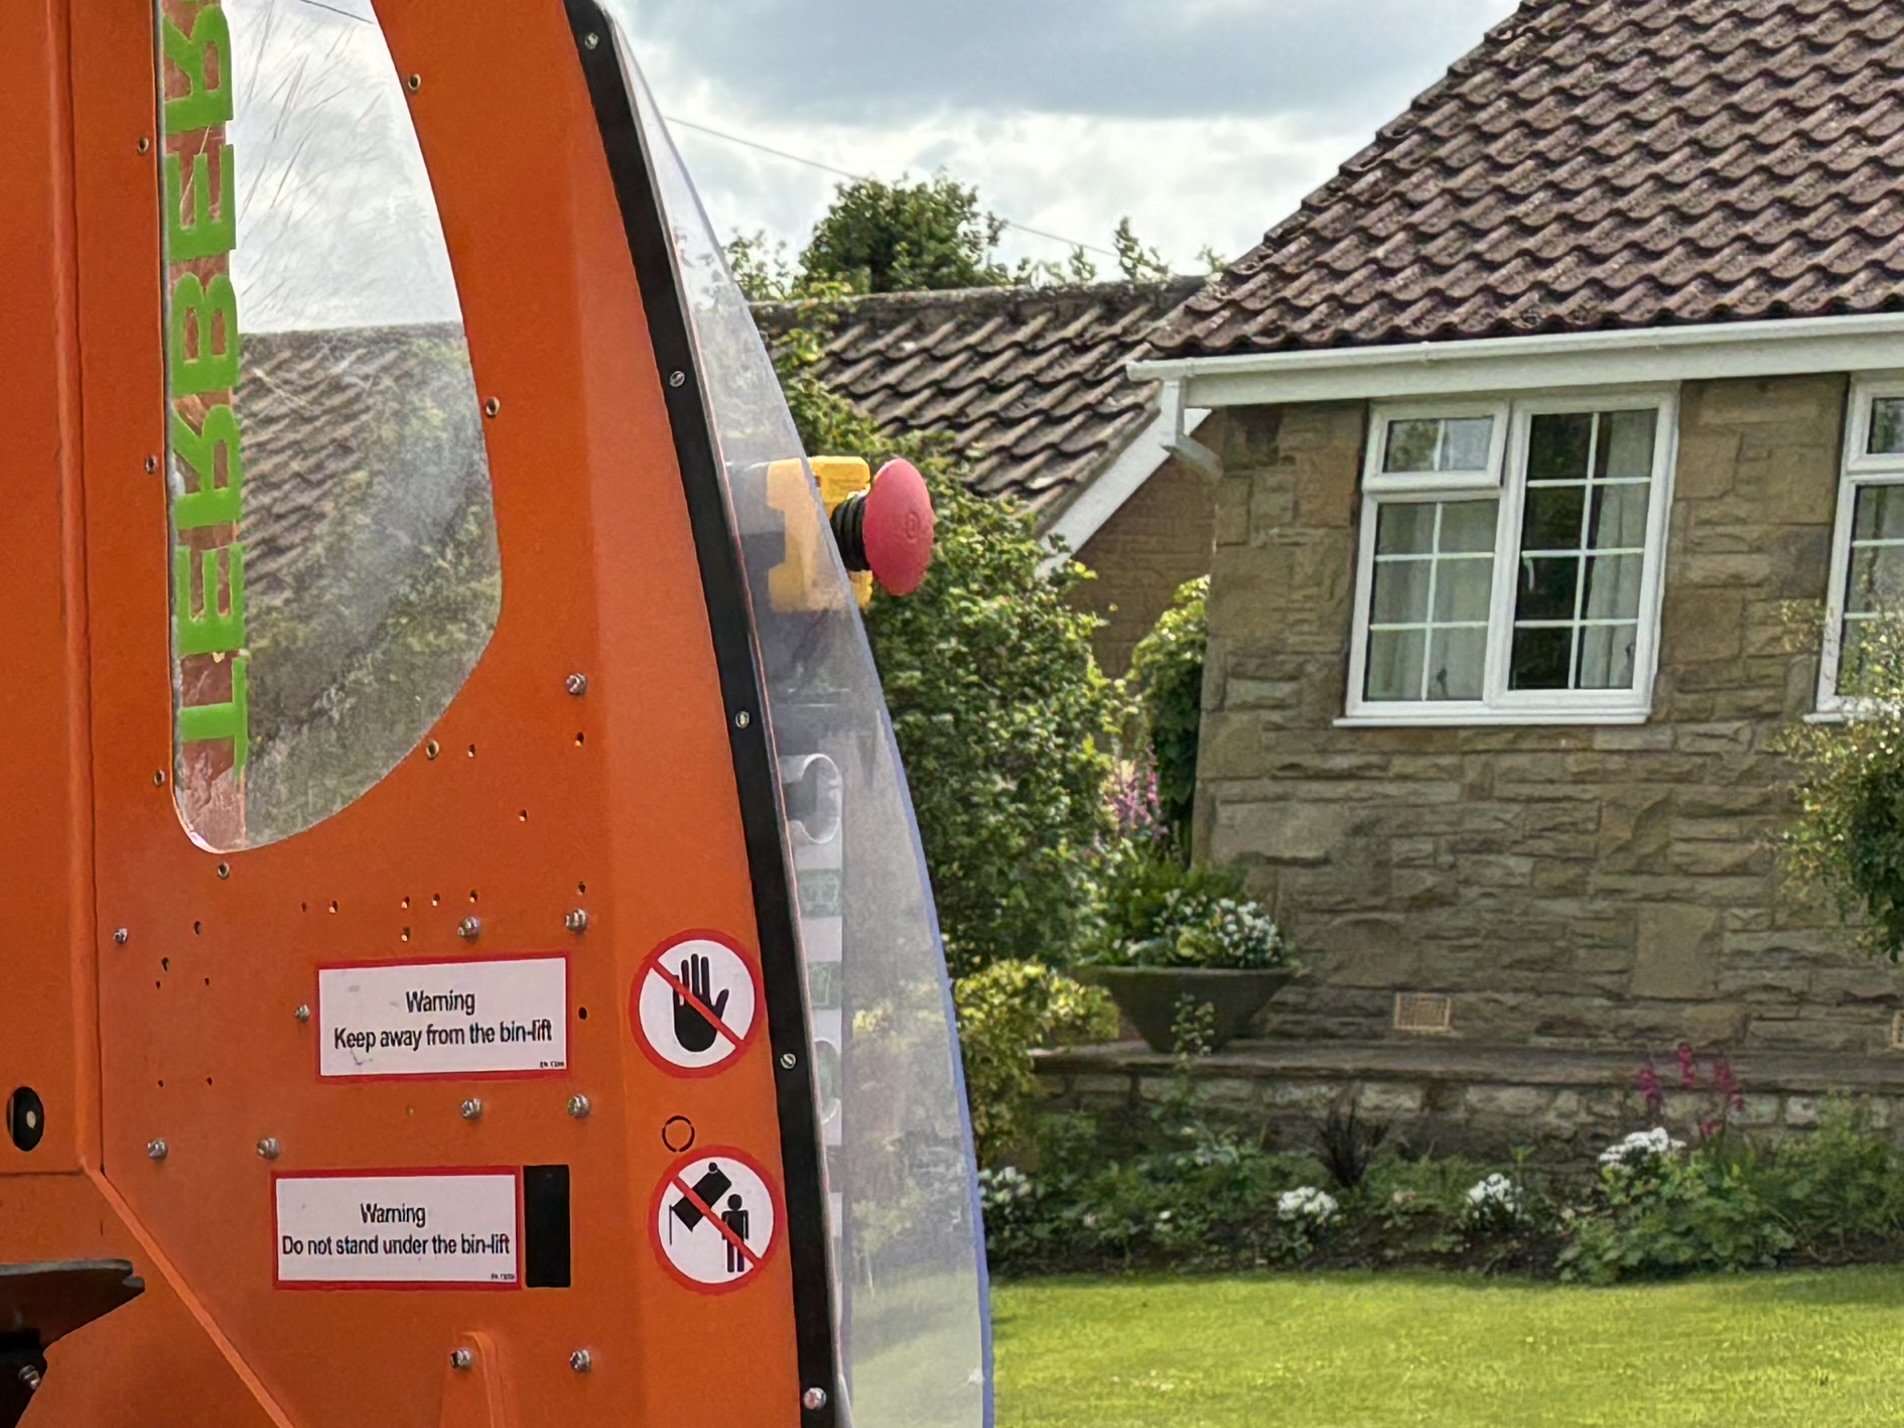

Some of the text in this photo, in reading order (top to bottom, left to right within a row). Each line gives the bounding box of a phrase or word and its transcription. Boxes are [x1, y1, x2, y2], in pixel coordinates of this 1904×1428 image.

[405, 990, 475, 1016] Warning
[334, 1019, 553, 1053] Keep away from the bin-lift
[360, 1203, 427, 1228] Warning
[282, 1233, 511, 1255] Do not stand under the bin-lift
